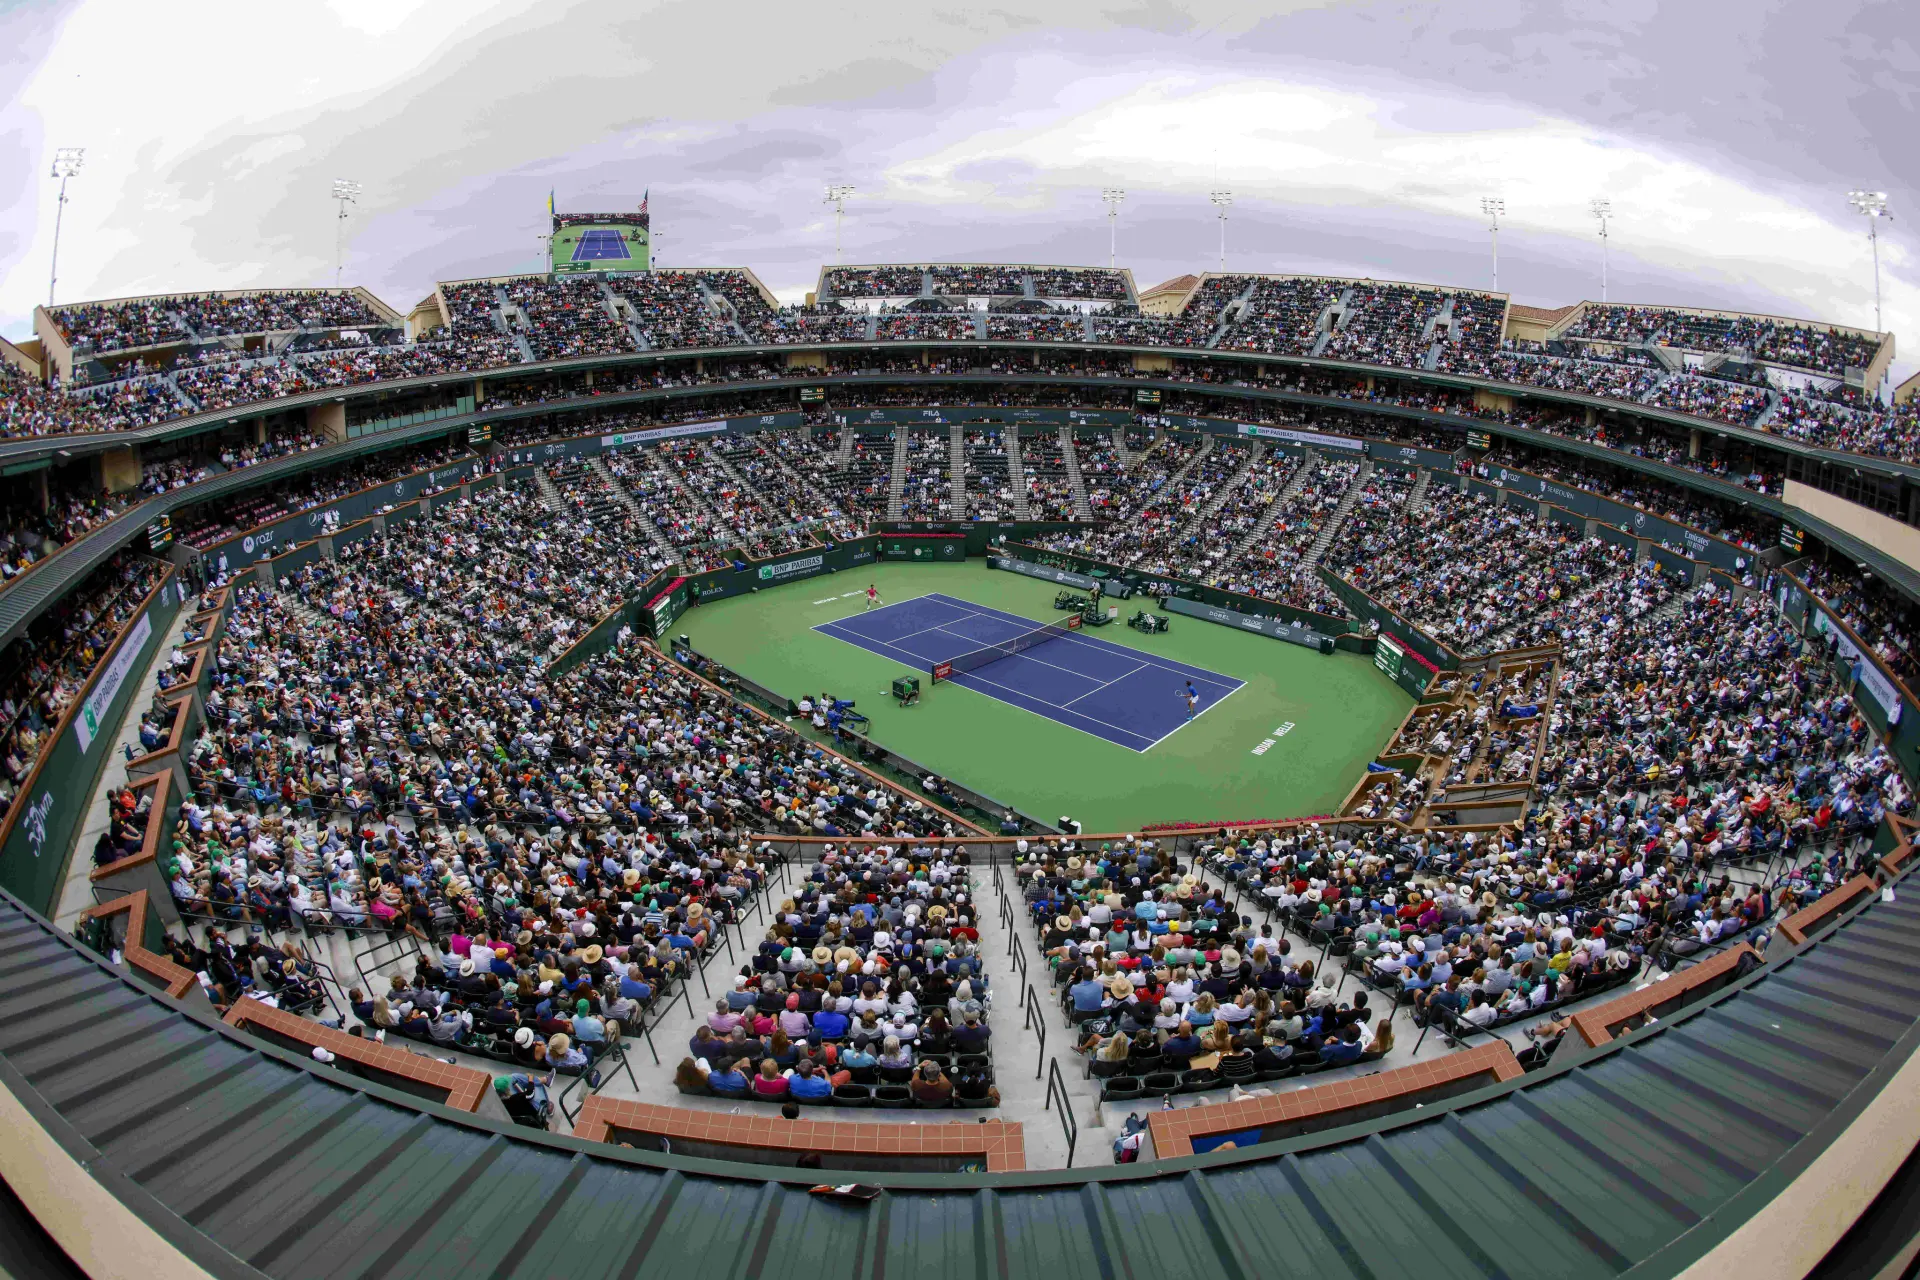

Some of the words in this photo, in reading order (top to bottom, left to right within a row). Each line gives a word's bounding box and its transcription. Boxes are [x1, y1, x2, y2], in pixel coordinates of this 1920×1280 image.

[637, 431, 662, 439] PARIBAS
[1270, 429, 1294, 438] PARIBAS
[1400, 447, 1417, 456] ATP
[1547, 485, 1575, 501] SEABOURN
[255, 530, 275, 548] razr
[1684, 530, 1709, 547] Emirates
[853, 551, 871, 560] ROLEX
[774, 564, 789, 574] BNP
[791, 556, 821, 569] PARIBAS
[702, 587, 724, 597] ROLEX
[1208, 610, 1231, 621] DOBEL
[1242, 617, 1265, 627] HOLOGIC
[93, 692, 104, 717] BNP
[102, 667, 119, 702] PARIBAS
[1250, 737, 1277, 756] INDIAN
[1272, 721, 1296, 737] WELLS
